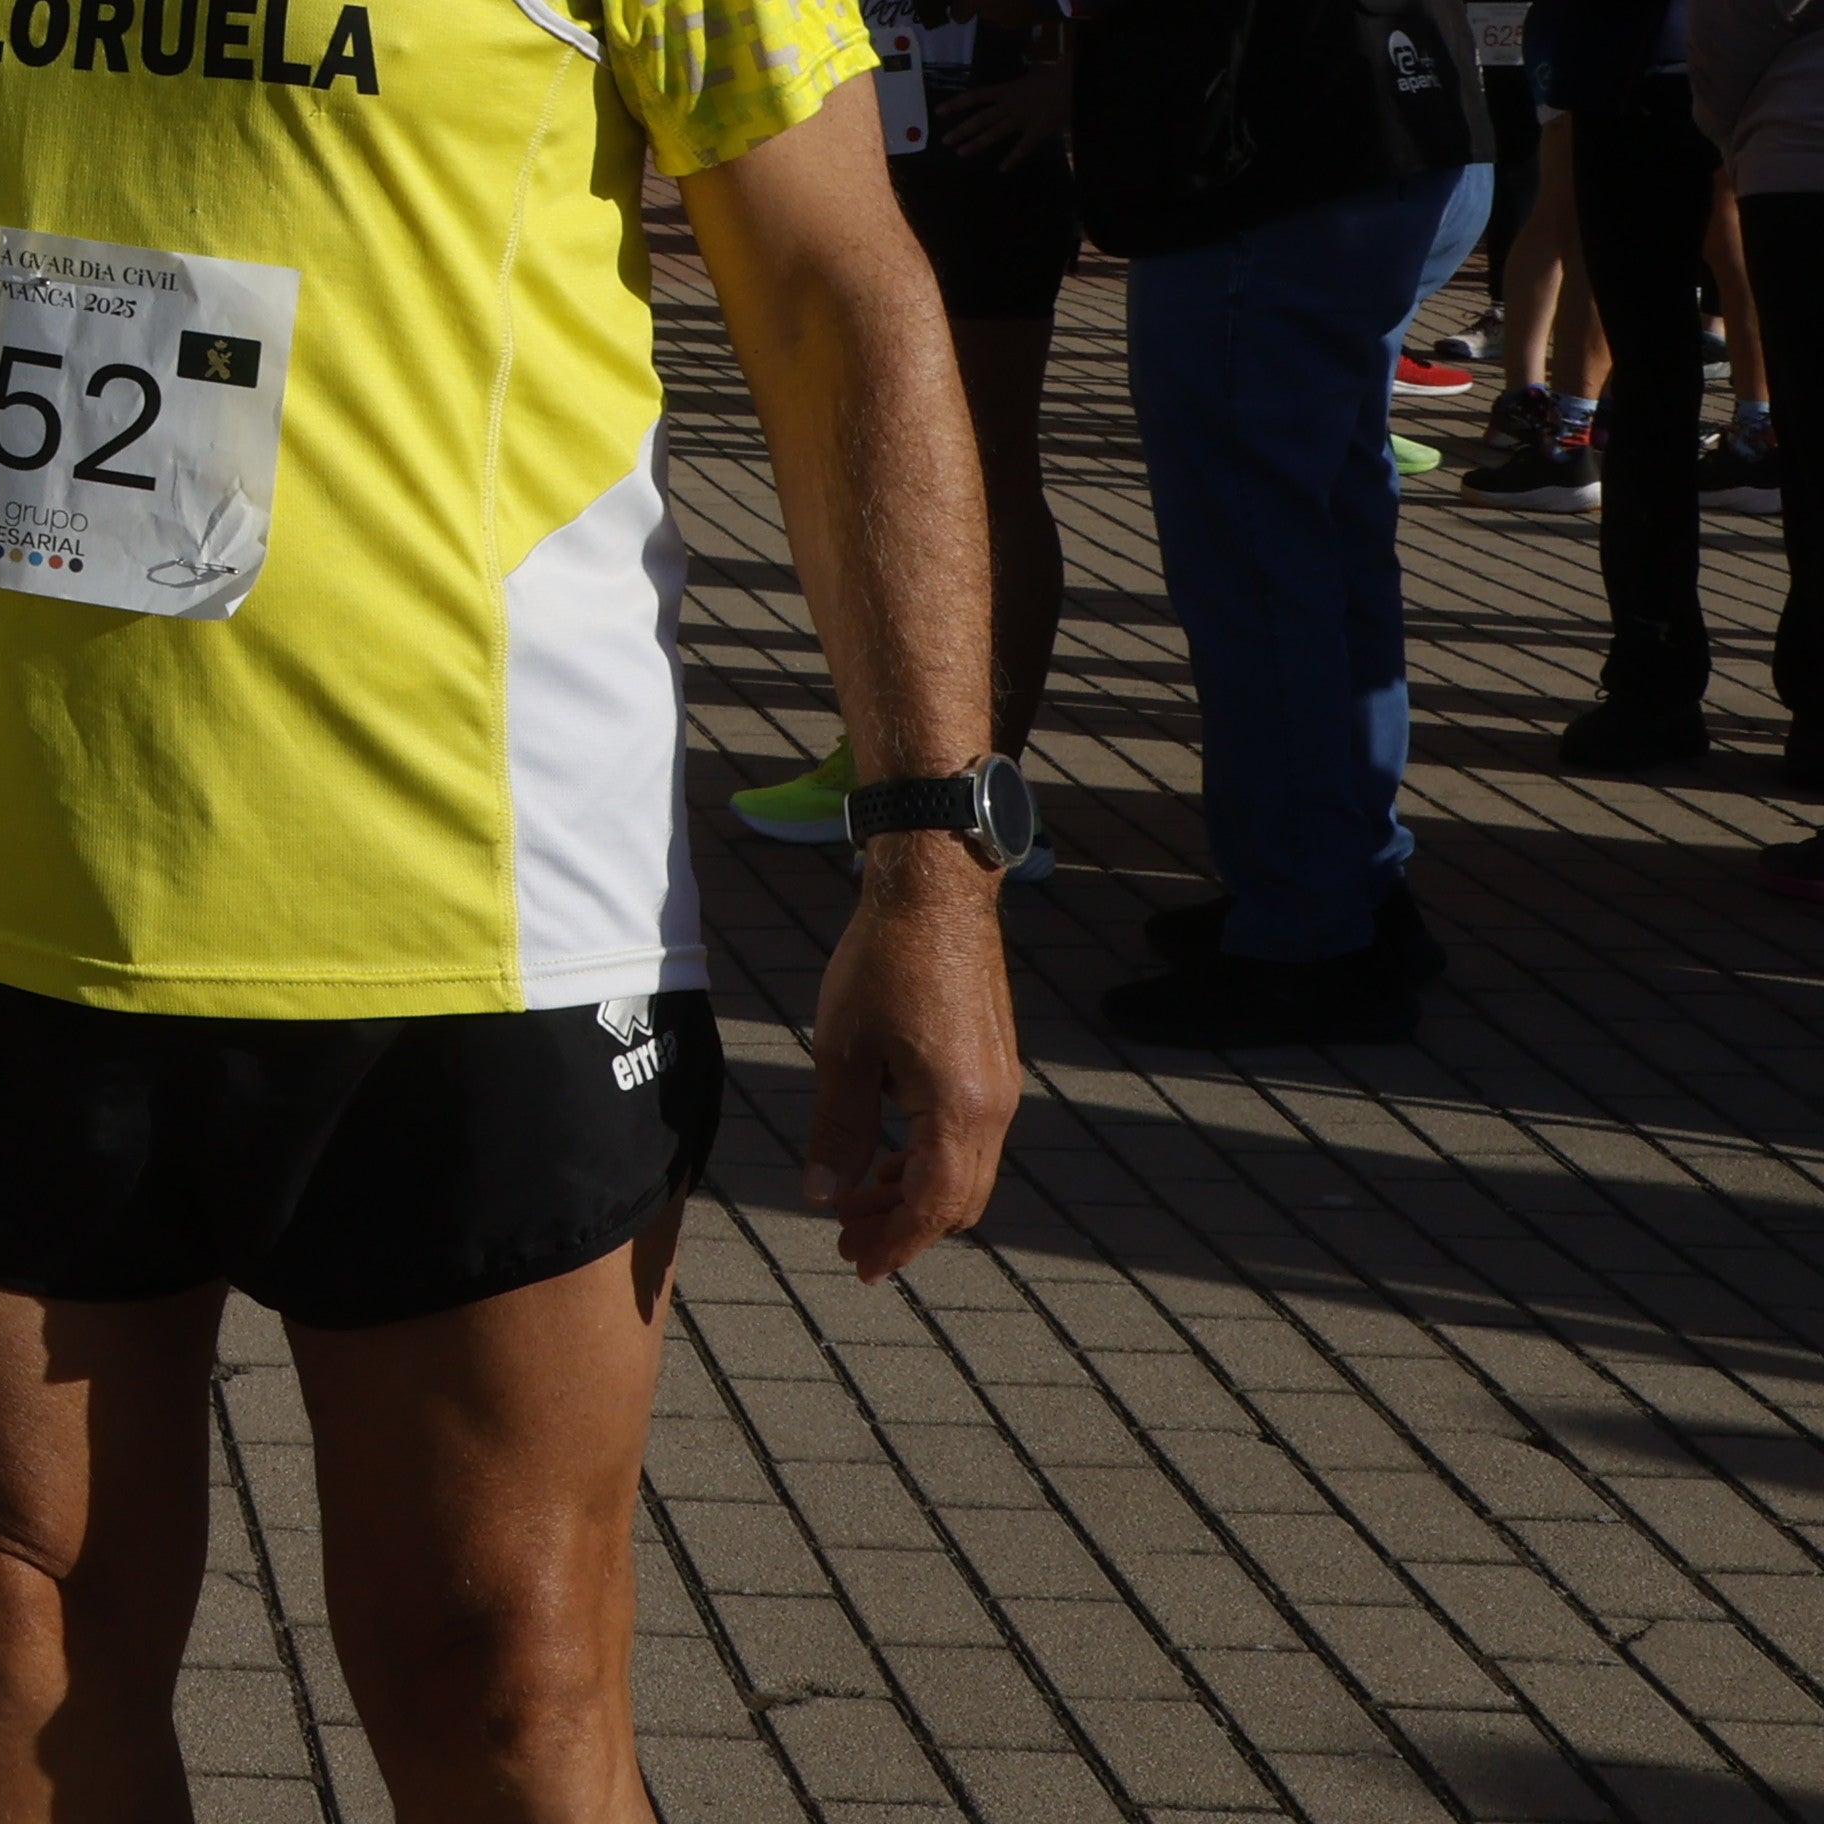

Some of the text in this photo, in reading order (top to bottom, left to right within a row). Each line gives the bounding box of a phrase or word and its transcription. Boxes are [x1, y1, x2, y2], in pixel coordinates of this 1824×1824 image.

[83, 293, 138, 318] 2025
[5, 498, 89, 532] grupo
[612, 1030, 677, 1091] errea
